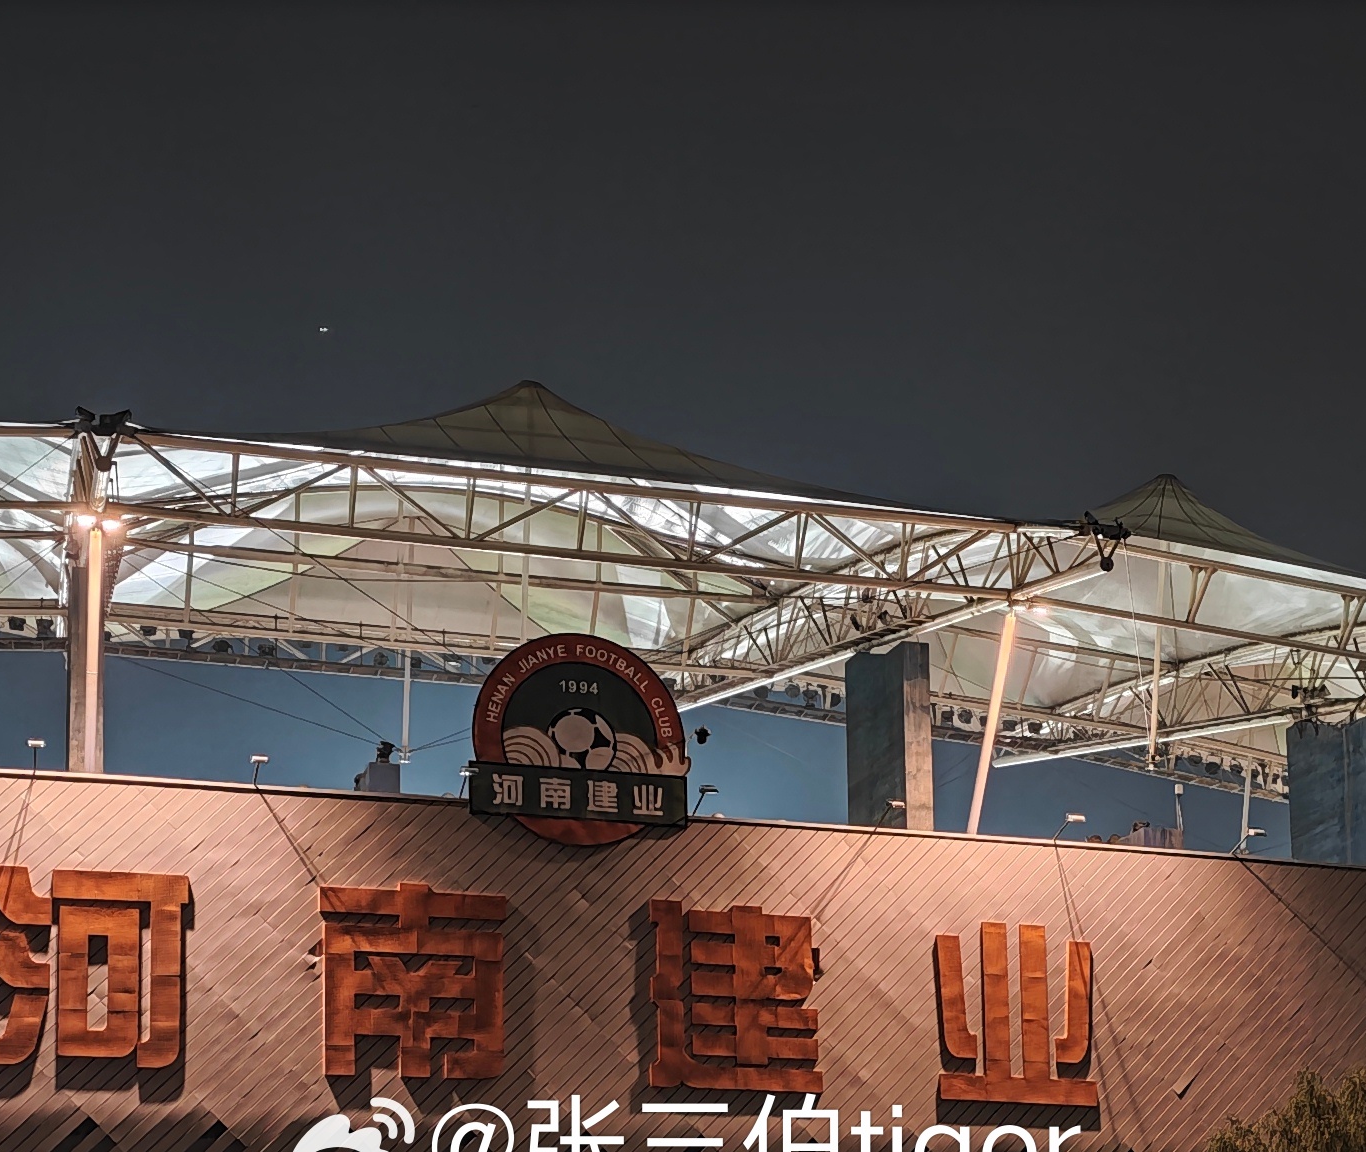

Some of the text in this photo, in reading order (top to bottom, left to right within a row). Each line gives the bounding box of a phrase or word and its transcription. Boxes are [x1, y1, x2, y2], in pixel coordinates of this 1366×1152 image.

[486, 644, 673, 739] HENAN JIANYE FOOTBALL CLUB
[559, 680, 599, 695] 1994
[492, 772, 664, 816] 河南建业
